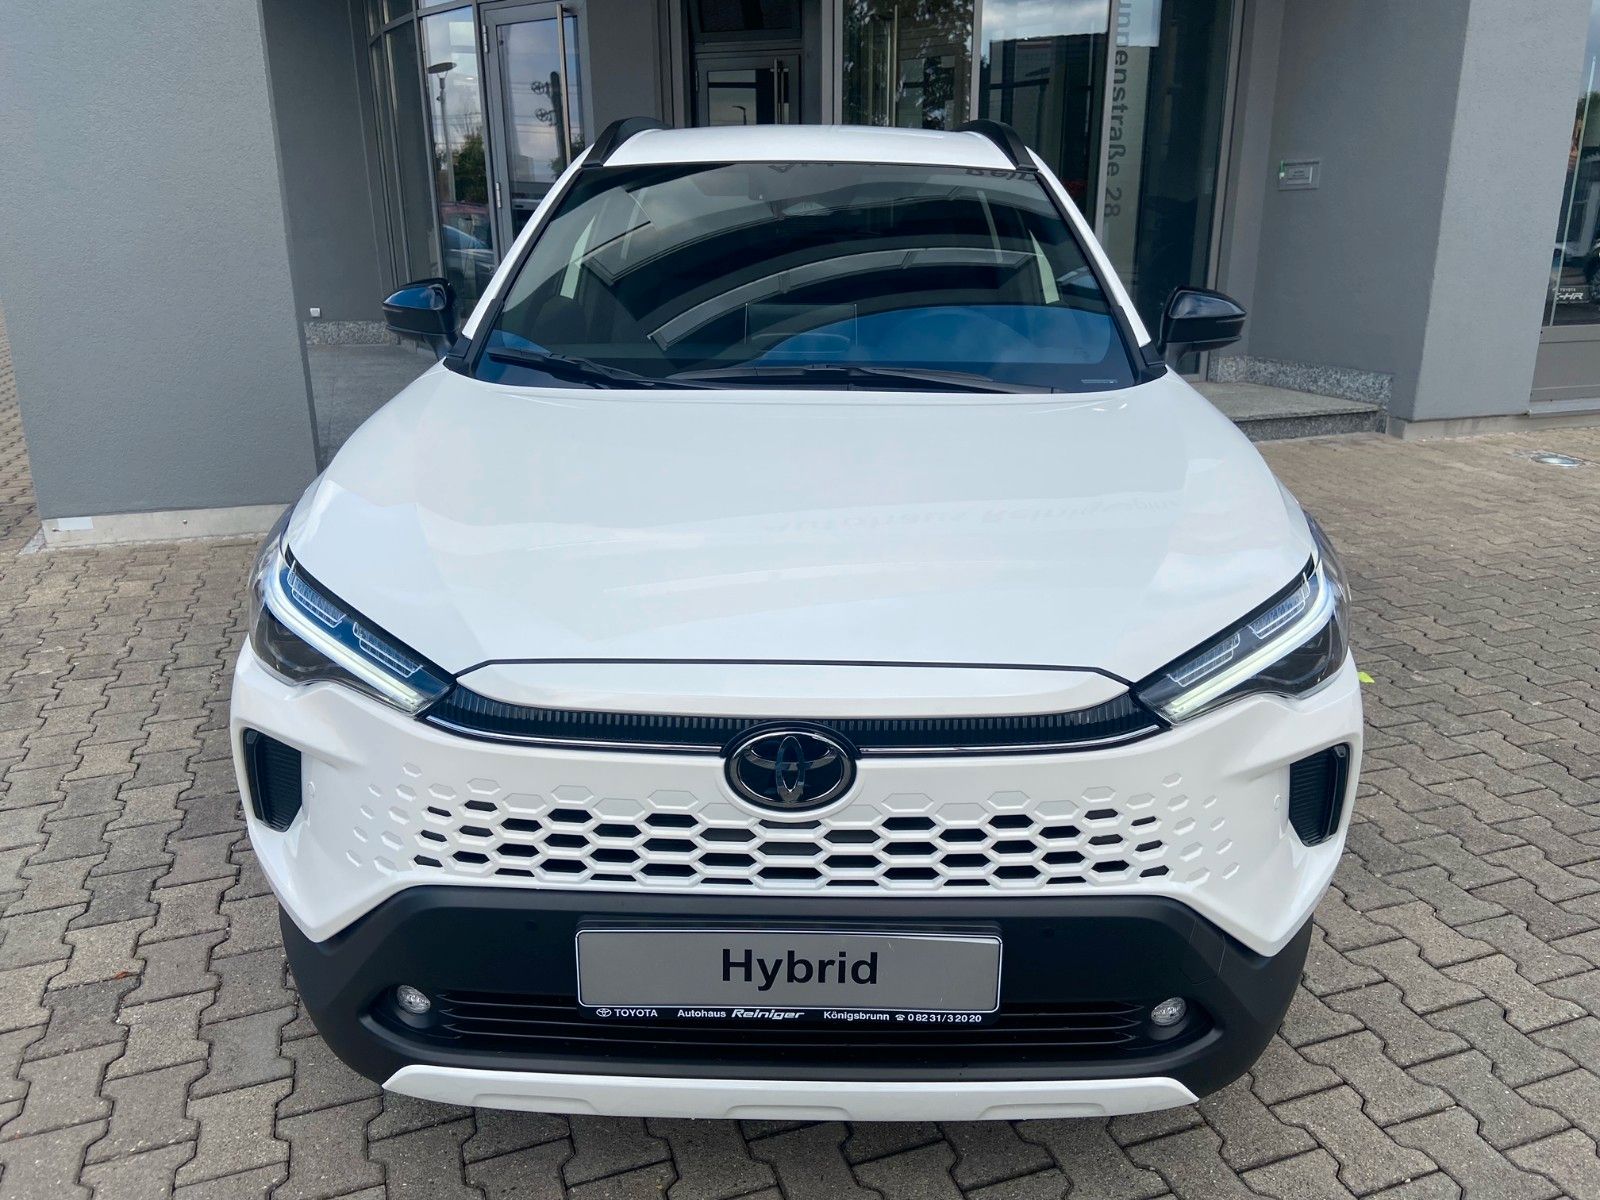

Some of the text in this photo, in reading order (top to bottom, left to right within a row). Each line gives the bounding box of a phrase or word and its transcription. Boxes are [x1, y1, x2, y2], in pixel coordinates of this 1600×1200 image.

[1104, 187, 1122, 217] 28
[722, 948, 878, 991] Hybrid
[614, 1008, 658, 1017] TOYOTA
[677, 1009, 727, 1018] Autohaus
[731, 1008, 805, 1020] Reiniger
[823, 1011, 890, 1022] Königsbrunn
